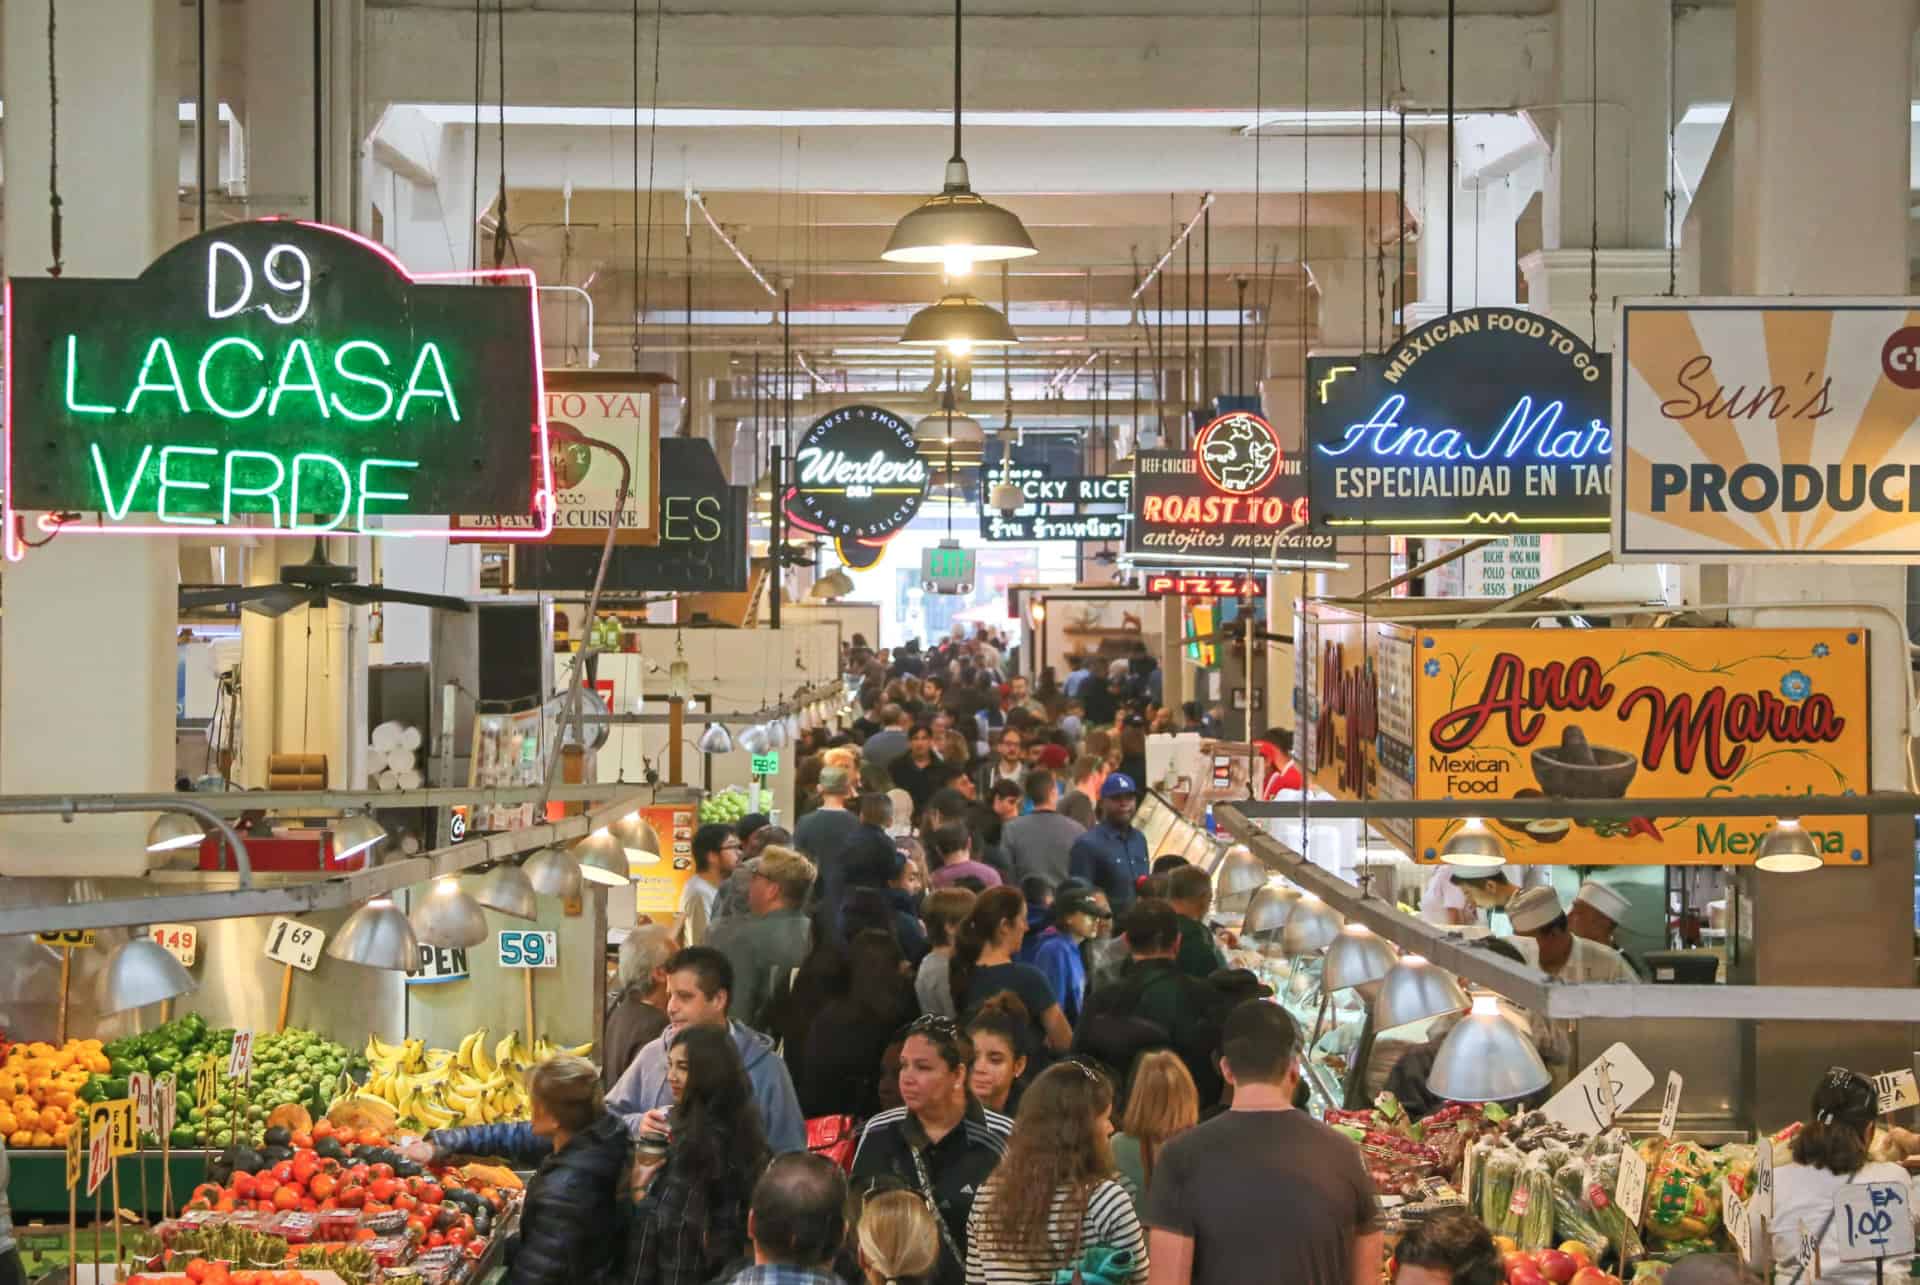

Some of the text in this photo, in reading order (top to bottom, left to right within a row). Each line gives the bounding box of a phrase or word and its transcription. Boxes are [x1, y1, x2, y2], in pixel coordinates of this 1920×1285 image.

[207, 241, 311, 324] D9
[1383, 313, 1600, 384] MEXICAN FOOD TO GO
[1660, 355, 1834, 420] Sun's
[808, 410, 915, 448] HOUSE SMOKED
[1318, 394, 1612, 460] Ana Mar
[91, 443, 419, 537] VERDE
[1079, 479, 1130, 499] RICE
[1335, 464, 1612, 499] ESPECIALIDAD EN TAC
[805, 496, 915, 535] HAND SLICED
[1143, 495, 1309, 525] ROAST TO G
[1143, 529, 1333, 553] antojitos mexicanos
[1153, 578, 1262, 594] PIZZA
[1430, 652, 1614, 755] Ana
[1617, 684, 1846, 780] Maria
[1429, 755, 1510, 775] Mexican
[1447, 776, 1499, 794] Food
[1696, 822, 1845, 855] Mexna
[291, 927, 312, 946] 69
[501, 932, 545, 966] 59
[408, 943, 468, 978] PEN
